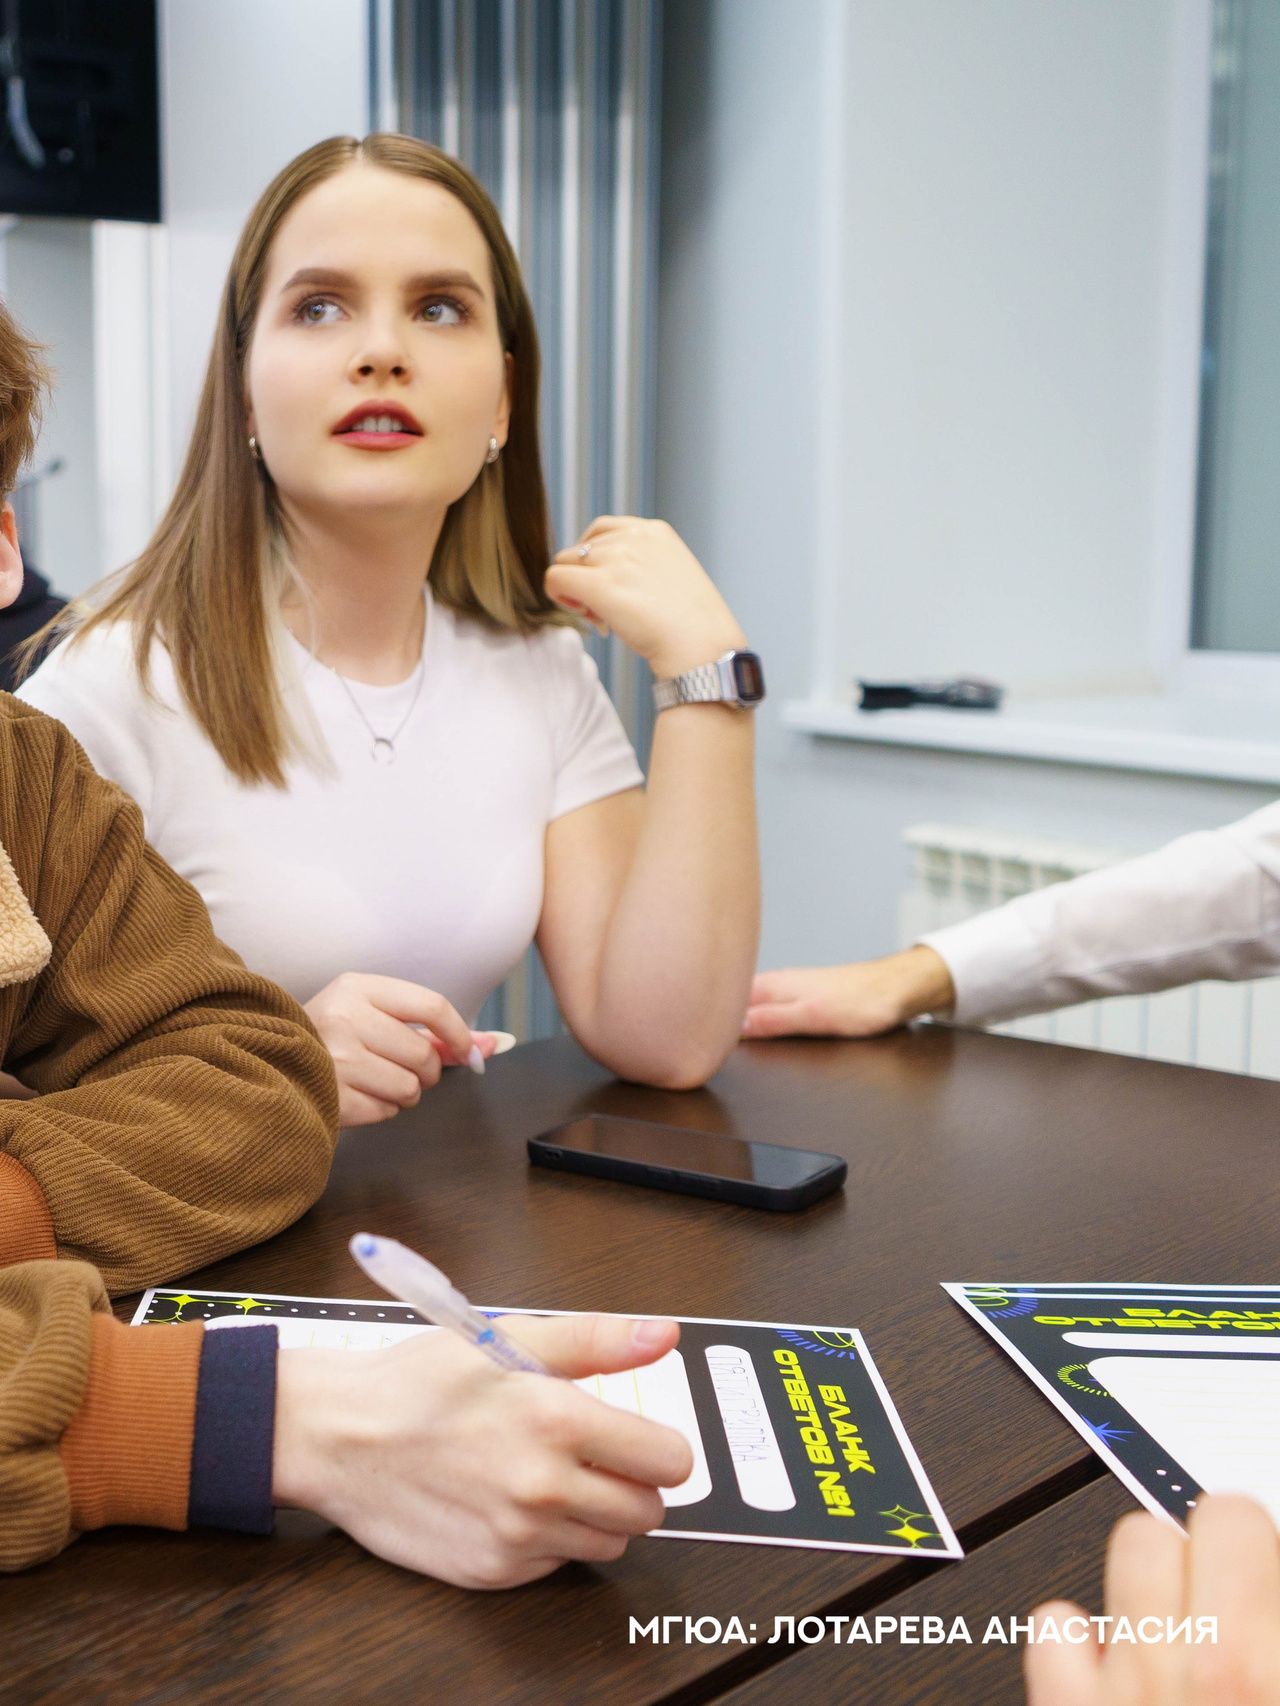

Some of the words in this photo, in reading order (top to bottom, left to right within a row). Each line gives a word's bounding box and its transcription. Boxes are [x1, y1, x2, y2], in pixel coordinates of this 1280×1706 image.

[1033, 1316, 1280, 1330] ОТВЕТО
[773, 1349, 835, 1465] ОТВЕТОВ
[814, 1470, 856, 1517] №1
[818, 1384, 876, 1475] БЛАНК
